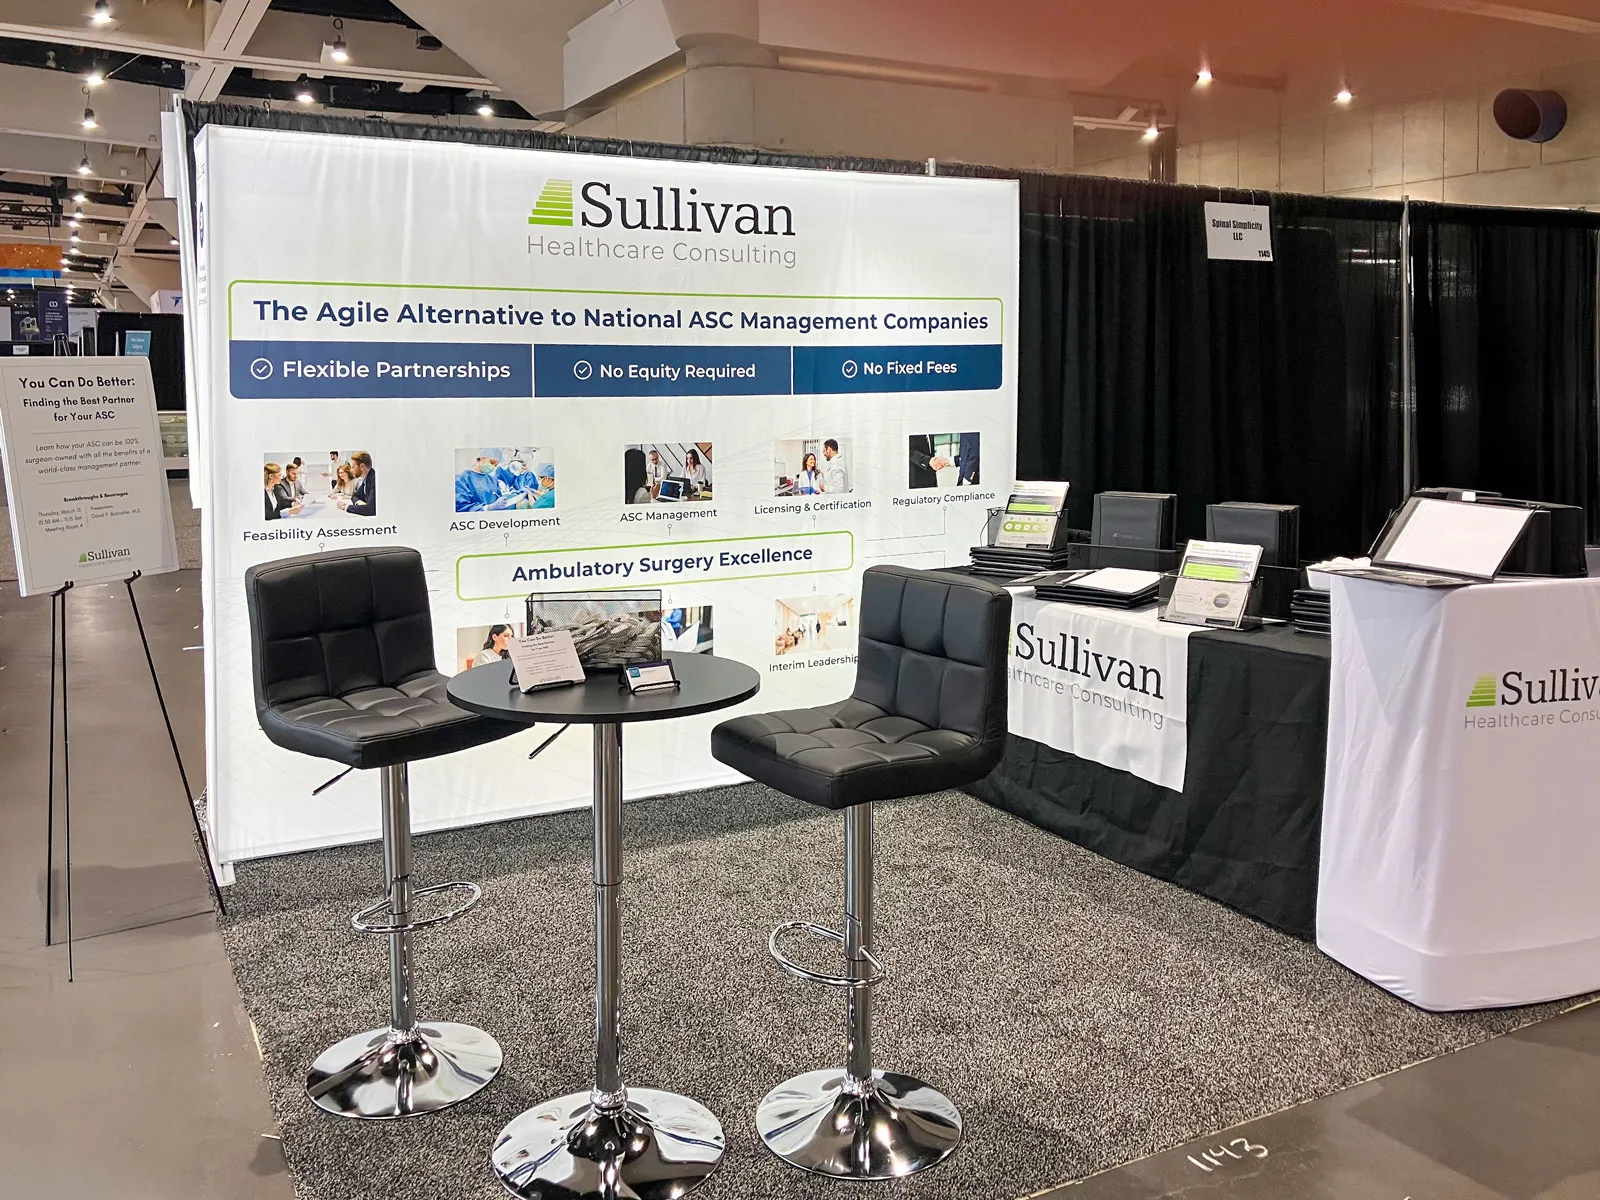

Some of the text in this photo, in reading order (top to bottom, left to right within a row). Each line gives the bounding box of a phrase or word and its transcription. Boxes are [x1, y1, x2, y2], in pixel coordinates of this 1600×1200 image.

[581, 181, 796, 236] Sullivan
[1212, 218, 1263, 231] Spinal Simplicity
[1233, 232, 1243, 241] LLC
[527, 235, 797, 269] Healthcare Consulting
[1258, 250, 1271, 258] 1145
[253, 300, 988, 334] The Agile Alternative to National ASC Management Companies
[282, 360, 511, 381] Flexible Partnerships
[600, 363, 756, 382] No Equity Required
[863, 359, 958, 375] No Fixed Fees
[19, 376, 136, 389] You Can Do Better:
[23, 395, 135, 409] Finding the Best Partner
[53, 411, 115, 421] for Your ASC
[71, 443, 85, 451] your
[25, 453, 77, 464] surgeon-owned
[78, 452, 92, 460] with
[113, 449, 138, 457] benefits
[38, 465, 76, 474] world-class
[77, 462, 118, 472] management
[754, 499, 872, 515] Licensing & Certification
[892, 491, 996, 507] Regulatory Compliance
[620, 508, 718, 522] ASC Management
[449, 516, 561, 531] ASC Development
[243, 524, 398, 541] Feasibility Assessment
[88, 548, 131, 562] Sullivan
[511, 548, 813, 582] Ambulatory Surgery Excellence
[769, 660, 805, 672] Interim
[1015, 622, 1164, 700] Sullivan
[1501, 668, 1600, 706] Sulliv
[1070, 683, 1164, 730] Consulting
[1464, 712, 1555, 729] Healthcare
[1187, 1138, 1268, 1172] 1143
